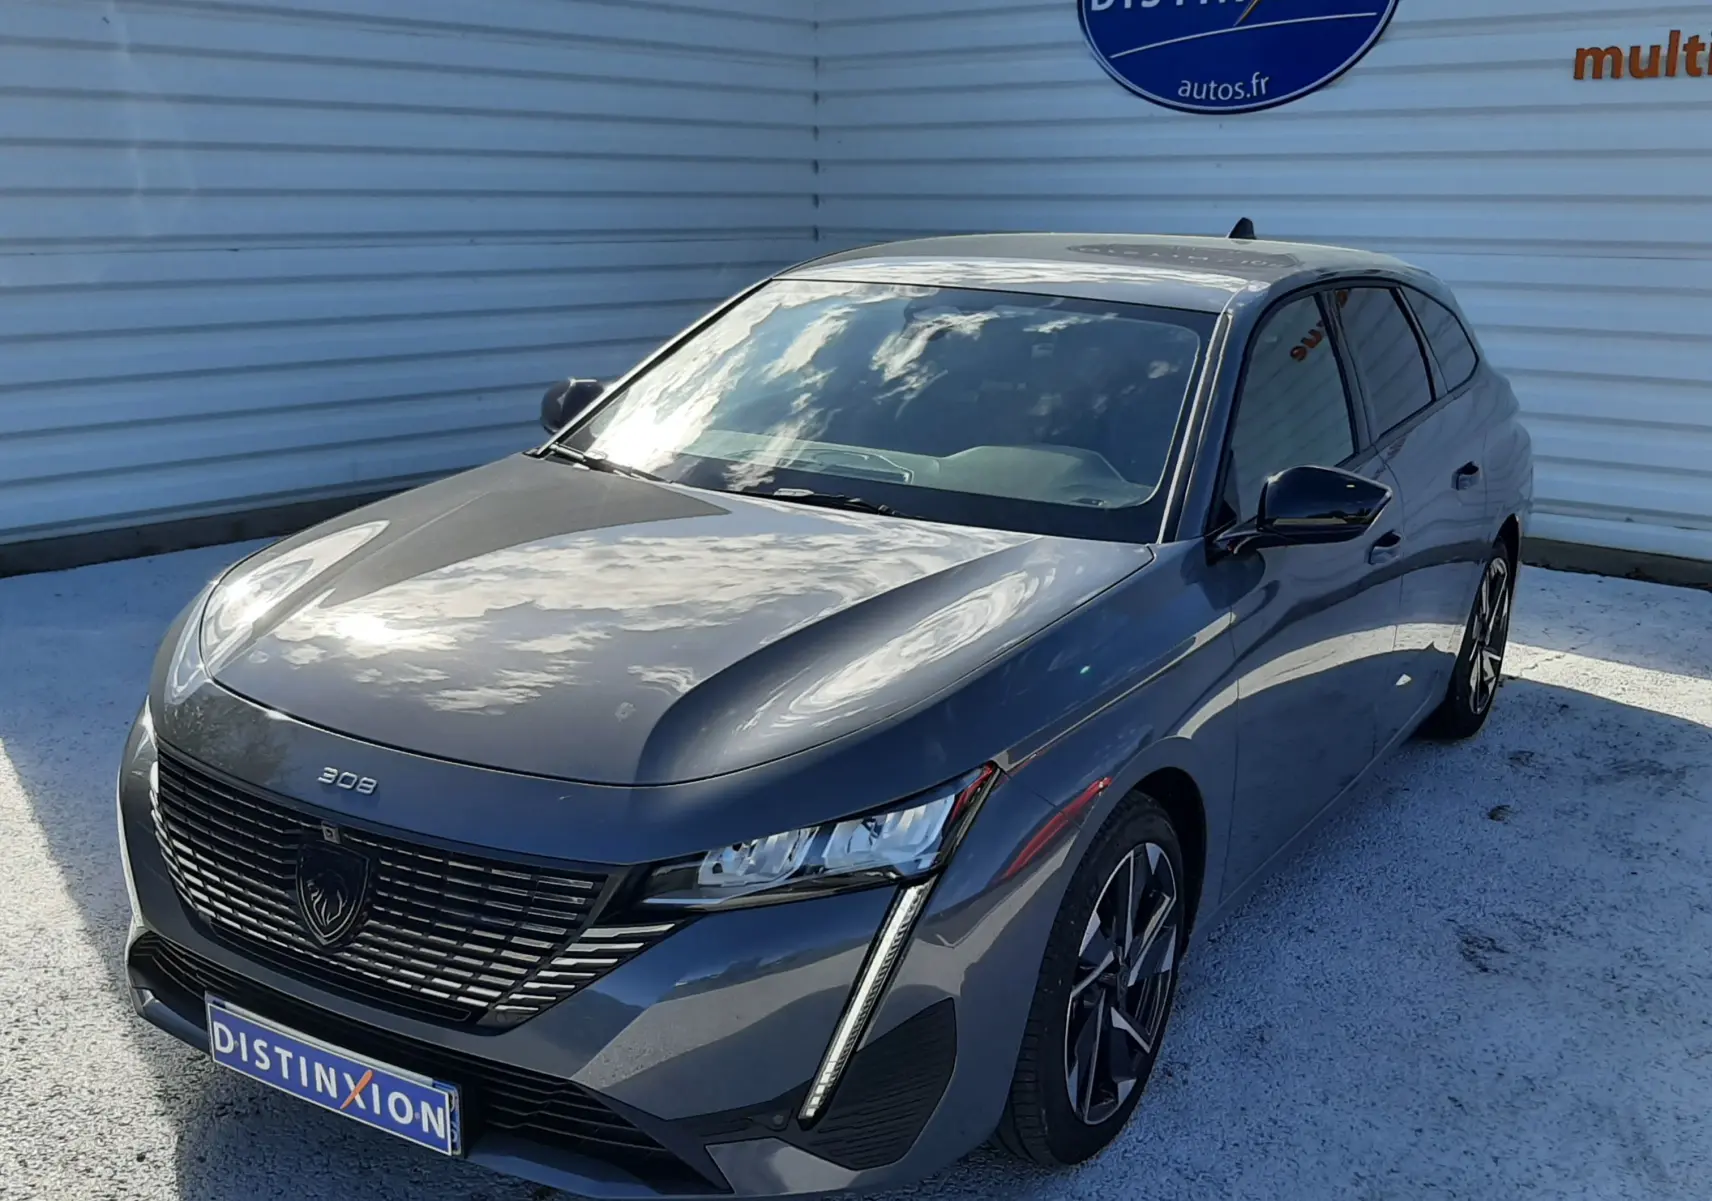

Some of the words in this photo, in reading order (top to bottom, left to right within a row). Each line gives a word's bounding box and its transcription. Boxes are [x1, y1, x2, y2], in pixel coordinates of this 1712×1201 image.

[1177, 71, 1270, 101] autos.fr
[317, 766, 378, 795] 308
[212, 1020, 446, 1139] DISTINXION
